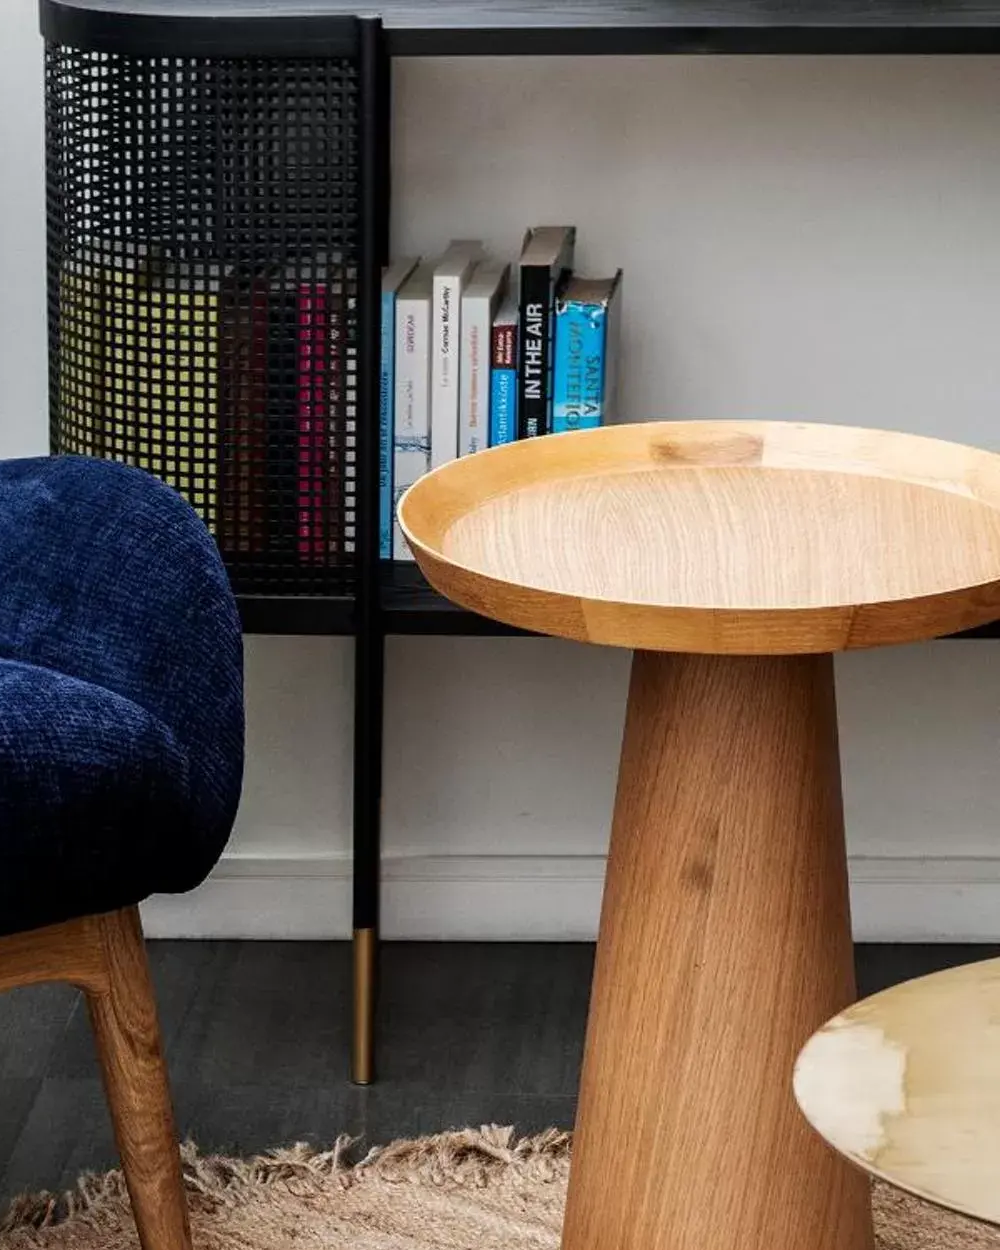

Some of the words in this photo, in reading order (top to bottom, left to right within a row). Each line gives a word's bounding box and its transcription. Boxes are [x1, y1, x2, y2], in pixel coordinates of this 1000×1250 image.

[441, 286, 452, 323] McCarthy
[526, 303, 543, 337] AIR
[440, 325, 450, 354] Cormac
[525, 339, 542, 378] THE
[524, 380, 541, 399] IN
[585, 355, 601, 415] SANTA
